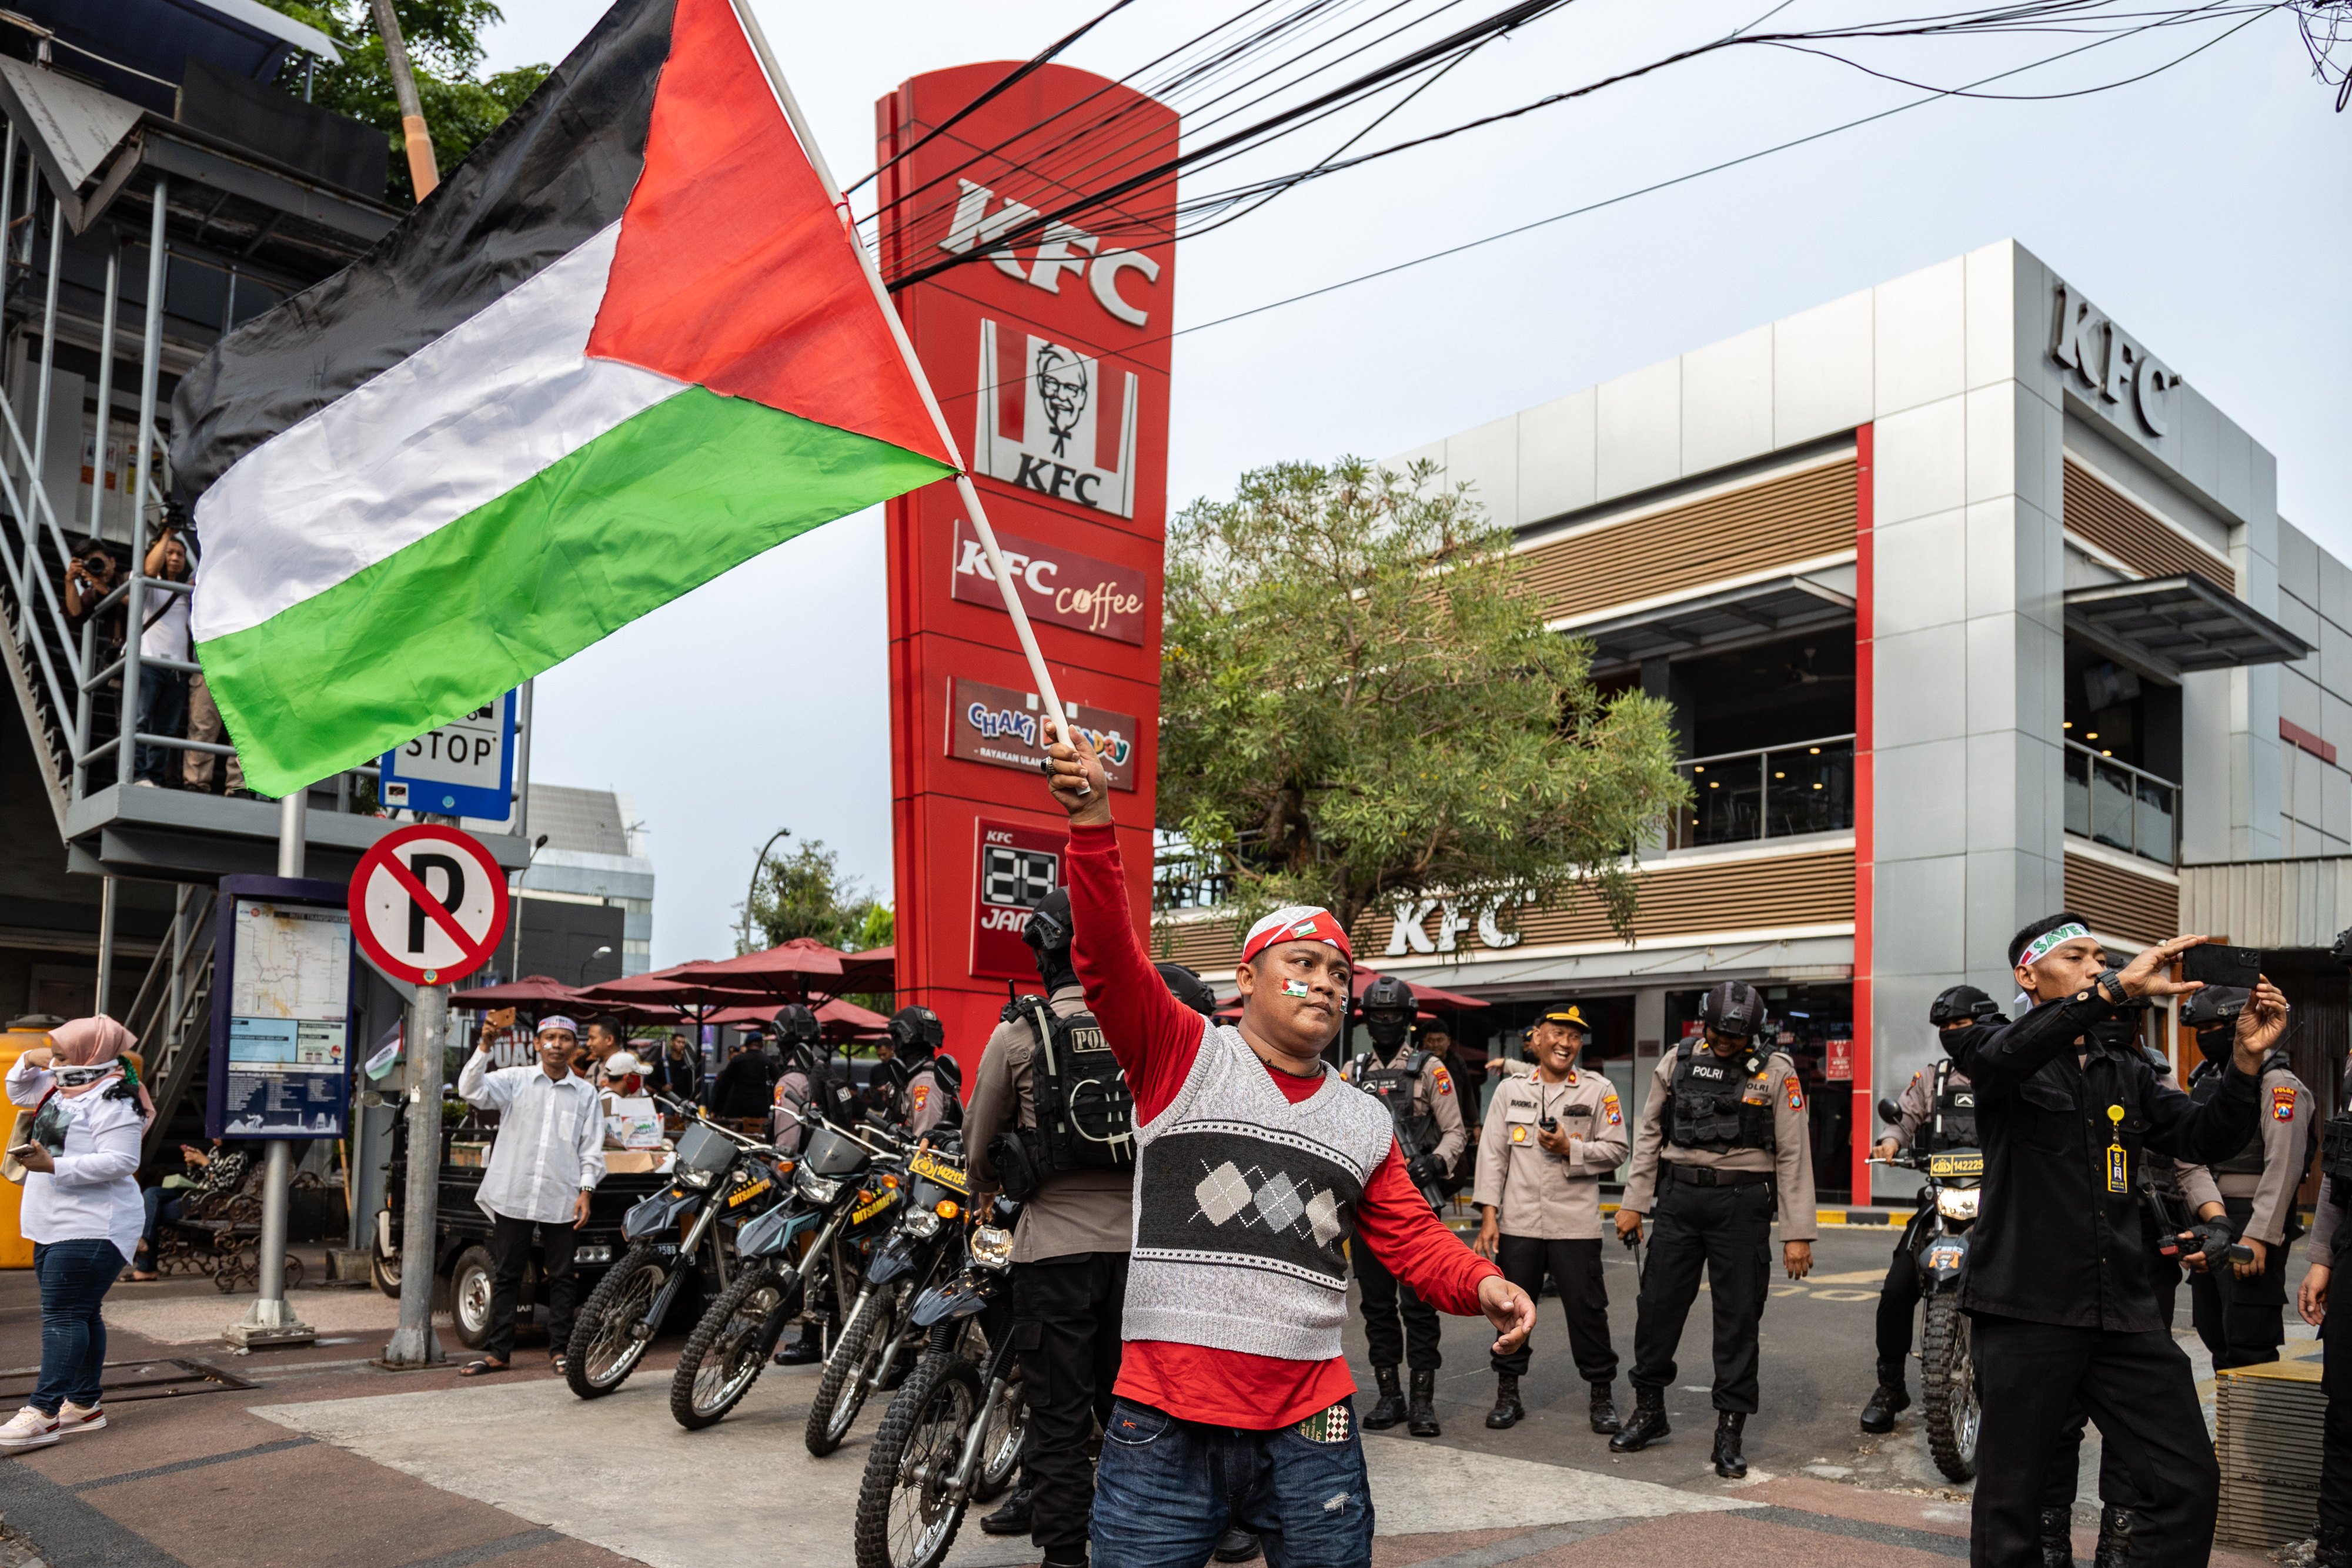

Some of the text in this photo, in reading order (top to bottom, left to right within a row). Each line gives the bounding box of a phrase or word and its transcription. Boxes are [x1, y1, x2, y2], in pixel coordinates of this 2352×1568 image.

[938, 178, 1161, 327] KFC
[2050, 282, 2180, 439] KFC
[1013, 453, 1101, 507] KFC
[968, 702, 1037, 745] CHAKI
[406, 731, 490, 765] STOP
[980, 747, 1019, 763] RAYAKAN
[986, 830, 1013, 844] KFC
[408, 854, 465, 953] P
[1384, 888, 1535, 956] KFC
[2033, 925, 2082, 954] SAVE
[1692, 1065, 1724, 1080] POLRI
[1746, 1083, 1769, 1093] OLRI
